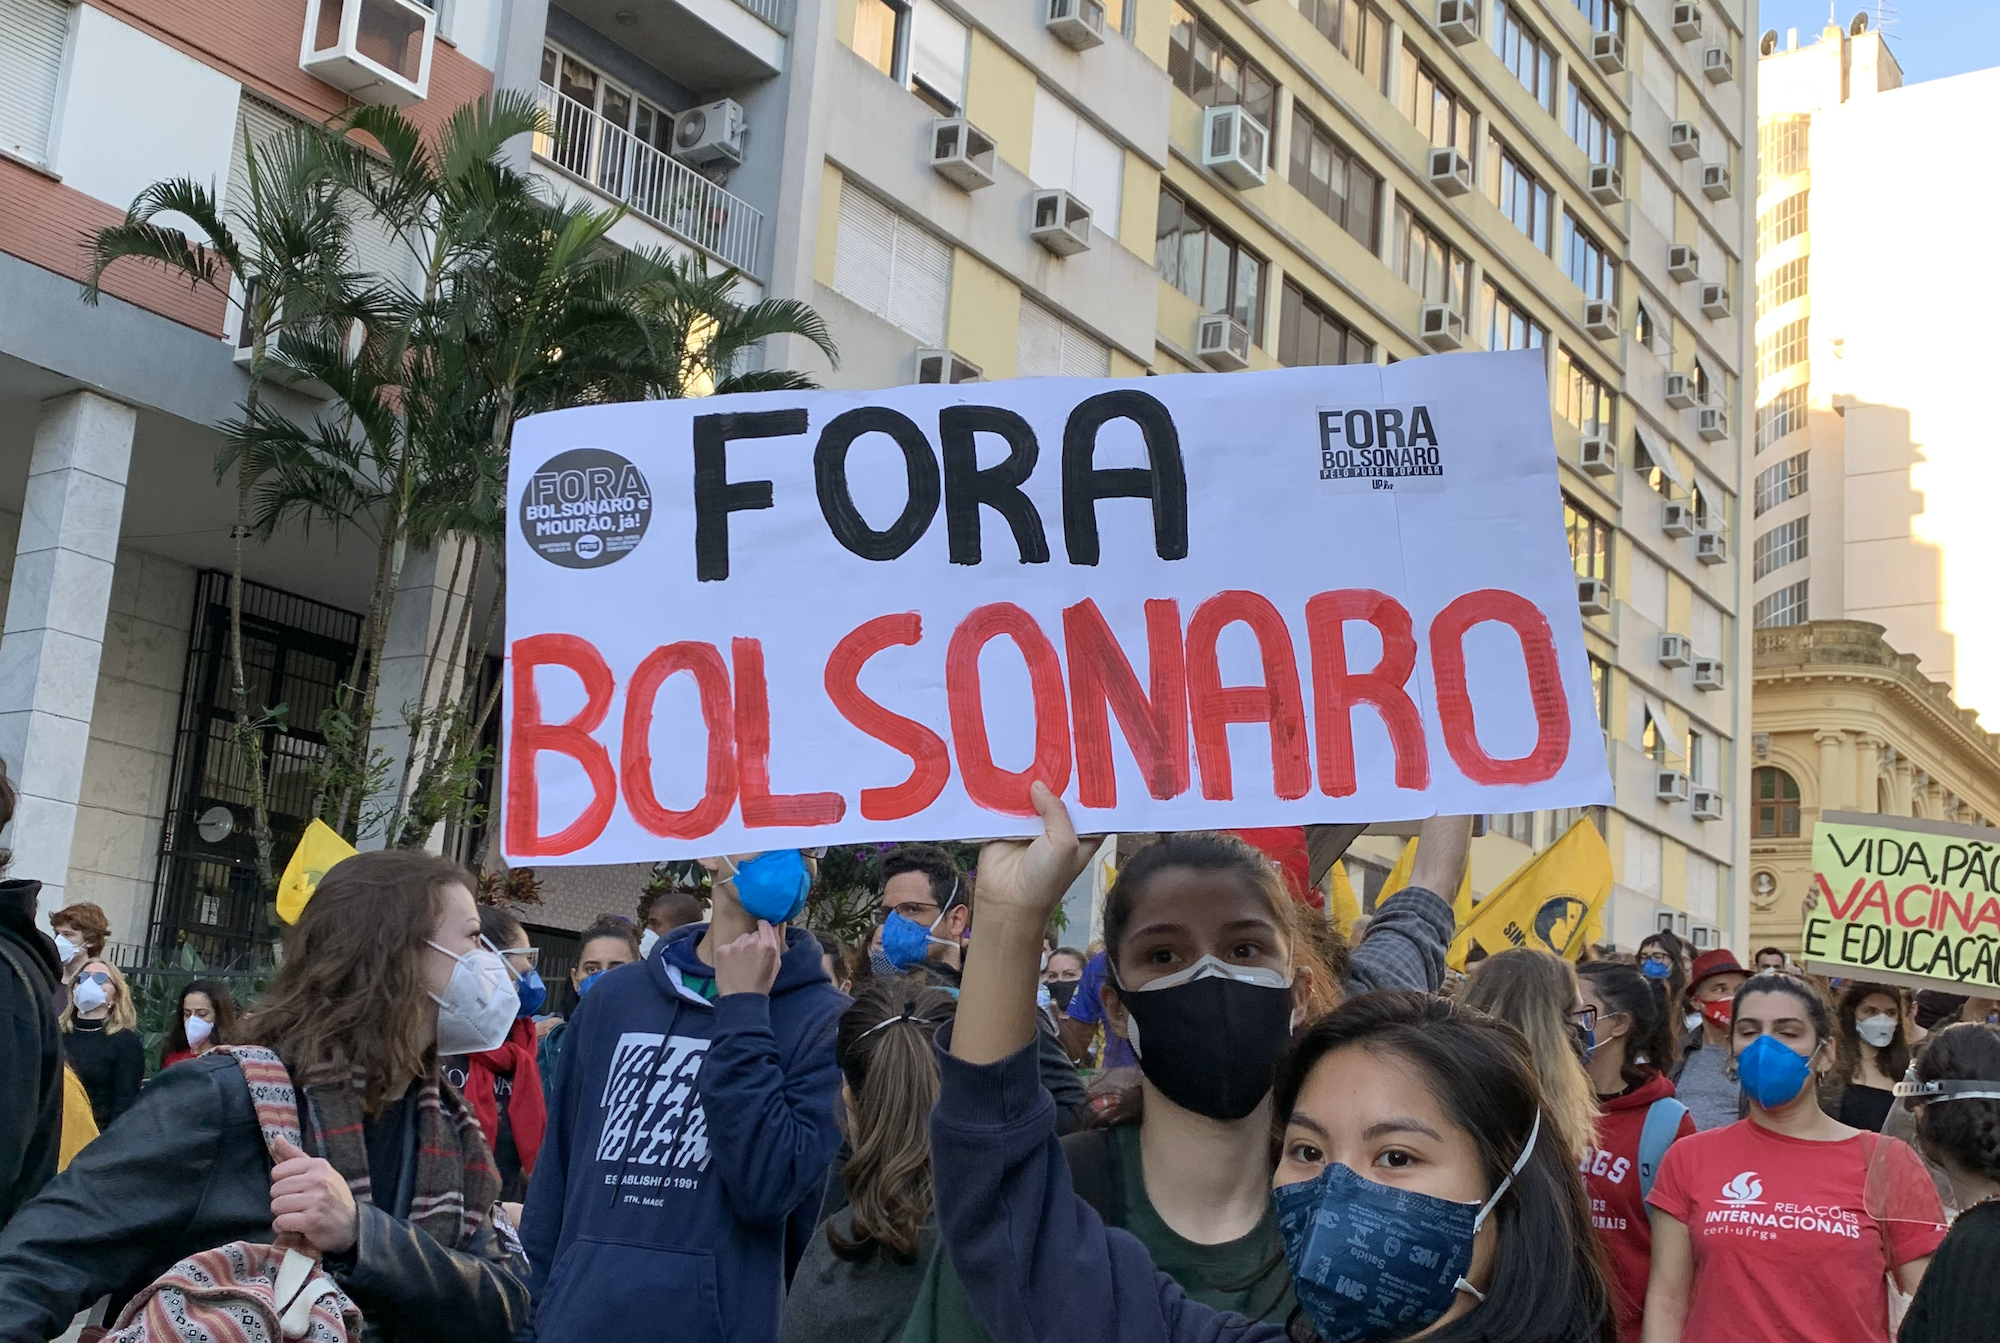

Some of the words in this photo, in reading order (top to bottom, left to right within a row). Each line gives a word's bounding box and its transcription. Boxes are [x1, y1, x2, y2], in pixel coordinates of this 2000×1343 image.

[1318, 405, 1438, 451] FORA
[1321, 446, 1440, 469] BOLSONARO
[530, 464, 650, 507] FORA
[692, 388, 1189, 583] FORA
[1323, 469, 1350, 479] PELO
[1355, 467, 1388, 477] PODER
[1393, 466, 1440, 476] POPULAR
[526, 497, 635, 520] BOLSONARO
[637, 499, 650, 510] e
[536, 514, 616, 537] MOURÃO,
[617, 513, 641, 533] já!
[505, 589, 1571, 859] BOLSONARO
[1814, 872, 2000, 935] VACINA
[1805, 917, 1831, 957] E
[1841, 922, 2000, 986] EDUCAÇÃ
[605, 1174, 671, 1188] ESABLISHD
[673, 1178, 698, 1190] 1991
[1705, 1210, 1860, 1239] INTERNACIONAIS
[1774, 1202, 1859, 1225] RELAÇÕES
